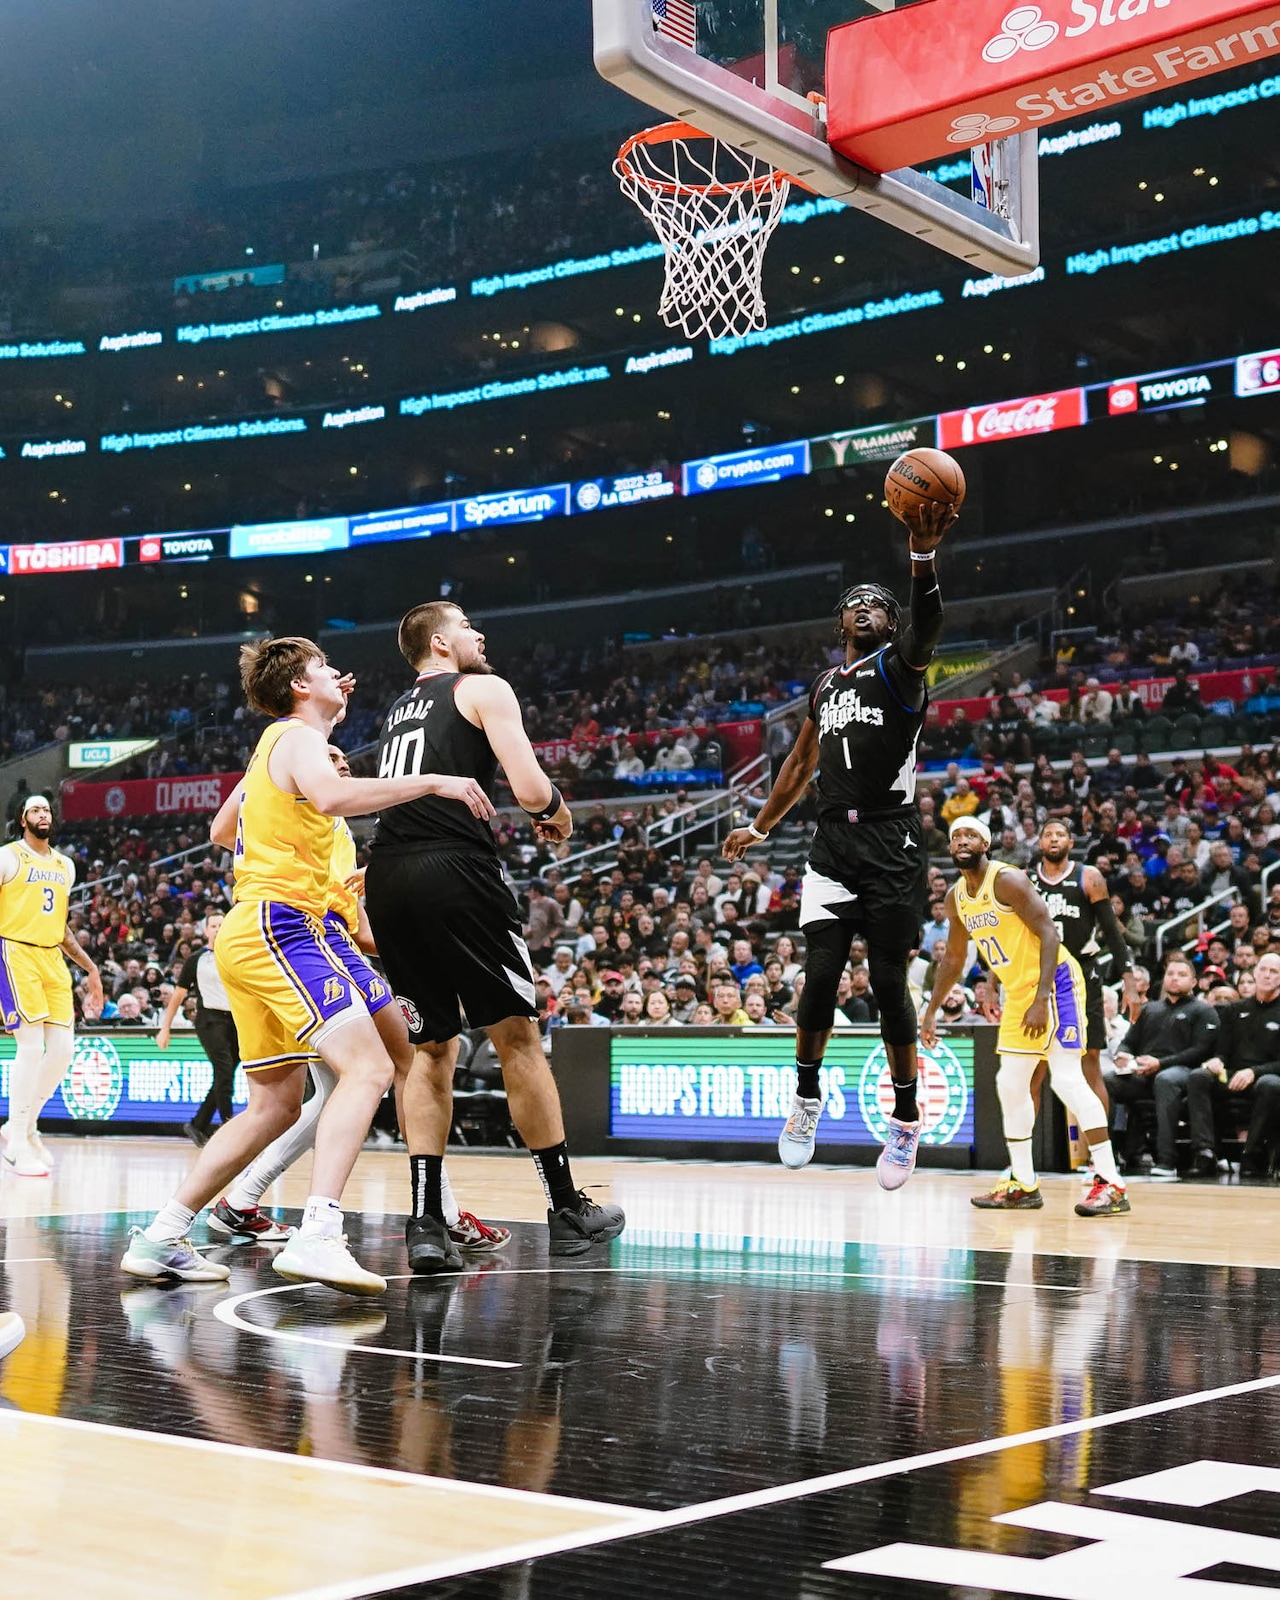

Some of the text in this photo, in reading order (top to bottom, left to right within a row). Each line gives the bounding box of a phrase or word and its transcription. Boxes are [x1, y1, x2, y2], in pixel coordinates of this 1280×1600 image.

[1143, 101, 1187, 128] High
[1188, 83, 1258, 115] Impact
[1038, 121, 1121, 156] Aspiration
[1066, 249, 1110, 275] High
[1111, 233, 1180, 263] Impact
[1180, 217, 1259, 248] Climate
[471, 281, 503, 296] High
[504, 265, 555, 288] Impact
[555, 254, 611, 277] Climate
[394, 287, 456, 311] Aspiration
[99, 331, 162, 351] Aspiration
[177, 325, 209, 343] High
[210, 318, 260, 339] Impact
[260, 313, 315, 331] Climate
[709, 335, 745, 355] High
[745, 321, 801, 346] Impact
[801, 308, 864, 333] Climate
[625, 346, 693, 374] Aspiration
[400, 397, 431, 416] High
[432, 387, 481, 409] Impact
[481, 377, 538, 400] Climate
[1139, 375, 1210, 402] TOYOTA
[323, 405, 385, 429] Aspiration
[21, 439, 86, 460] Aspiration
[101, 434, 133, 453] High
[134, 429, 183, 449] Impact
[183, 425, 238, 442] Climate
[718, 453, 794, 480] crypto.com
[464, 494, 552, 524] Spectrum
[602, 492, 618, 505] LA
[15, 543, 116, 570] TOSHIBA
[163, 538, 214, 554] TOYOTA
[829, 688, 857, 709] Los
[387, 699, 434, 732] ZUBAC
[818, 696, 884, 744] Angeles
[84, 749, 108, 760] UCLA
[379, 727, 425, 778] 40
[842, 737, 852, 770] 1
[156, 778, 221, 812] CLIPPERS
[26, 867, 66, 883] LAKERS
[43, 887, 55, 914] 3
[980, 936, 1013, 969] 21
[128, 1061, 181, 1102] HOOPS
[619, 1064, 698, 1115] HOOPS
[700, 1065, 744, 1116] FOR
